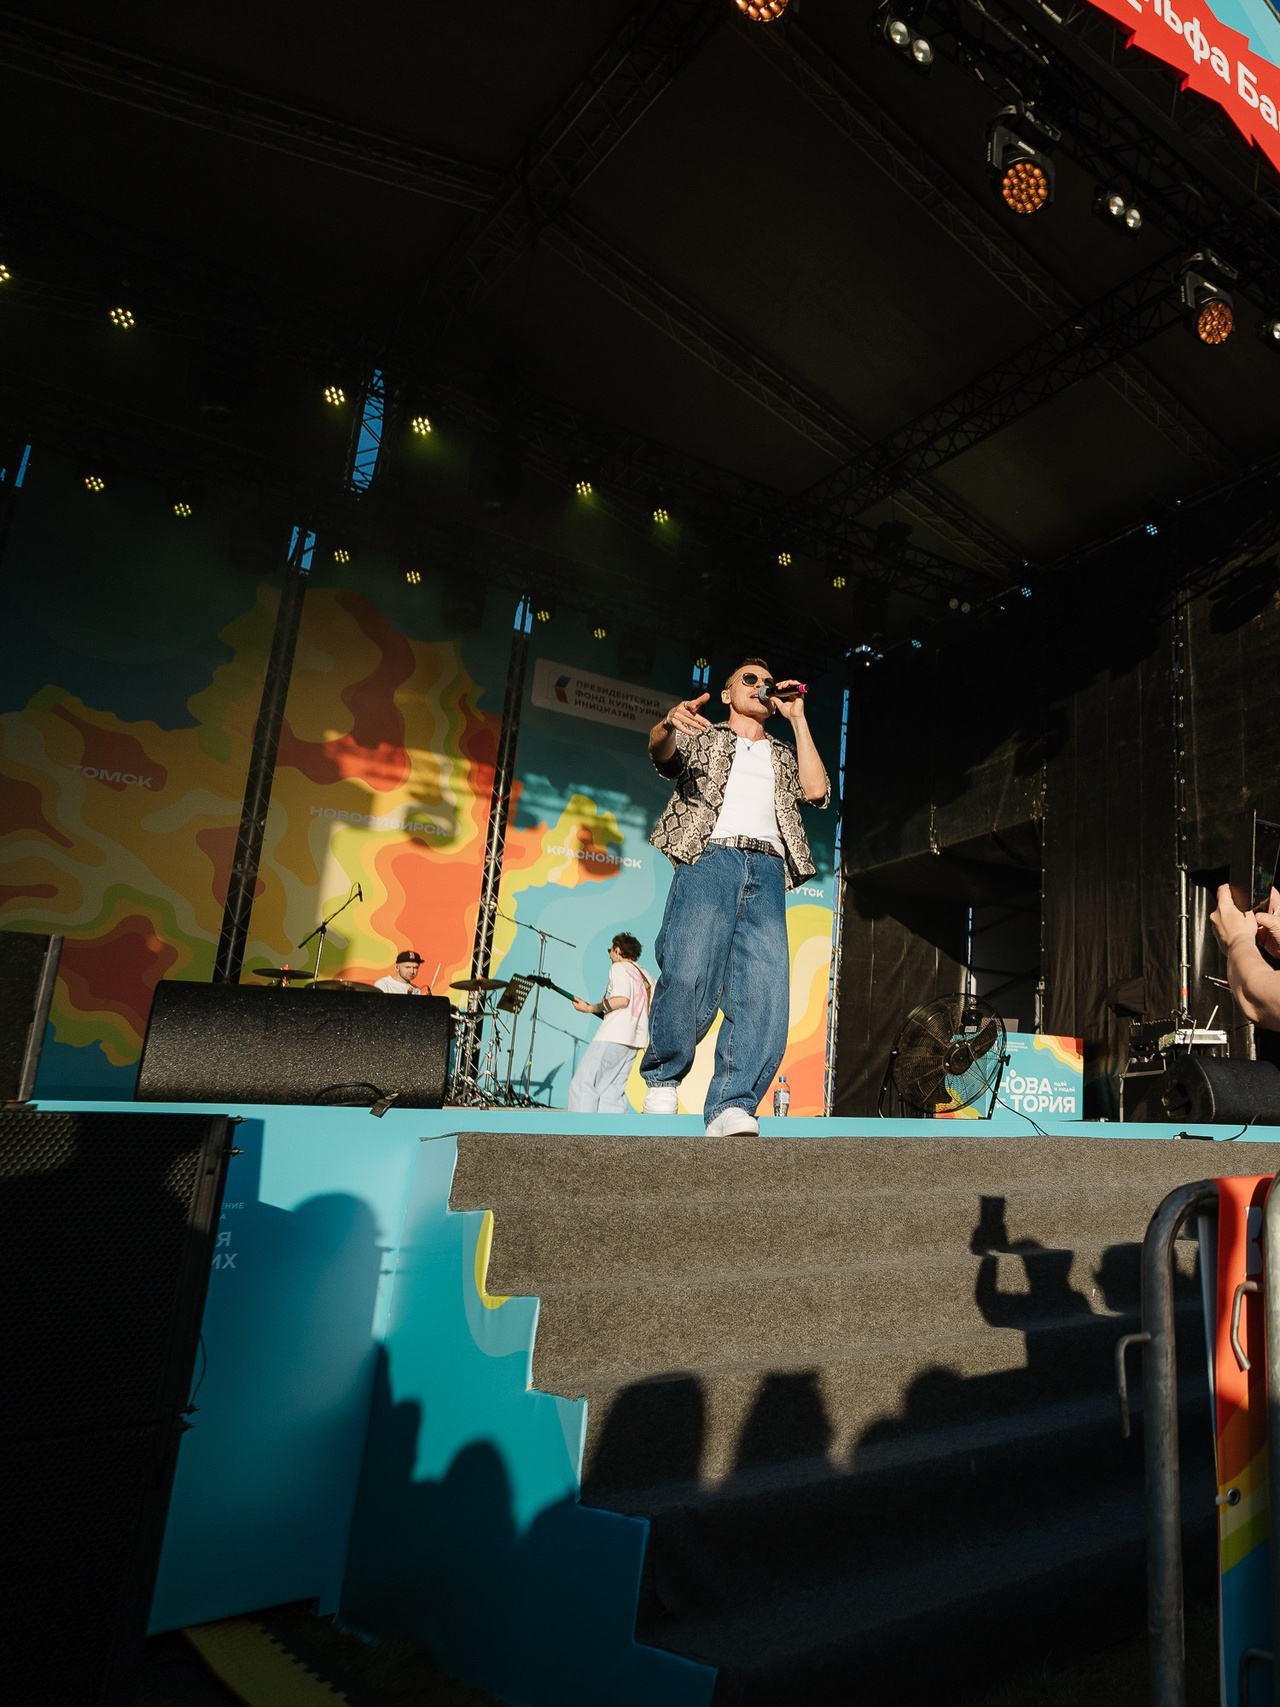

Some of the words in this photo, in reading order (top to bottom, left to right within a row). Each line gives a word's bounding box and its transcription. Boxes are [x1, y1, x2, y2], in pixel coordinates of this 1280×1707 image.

[575, 689, 606, 704] ФОНД
[609, 698, 667, 719] КУЛЬТУРНЫ
[576, 680, 660, 709] ПРЕЗИДЕНТСКИЙ
[574, 699, 636, 721] ИНИЦИАТИВ
[69, 764, 153, 789] ТОМСК
[309, 805, 449, 837] НОВОСИБИРСК
[547, 844, 642, 869] КРАСНОЯРСК
[998, 1074, 1053, 1095] НОВА
[1010, 1094, 1076, 1114] ТОРИЯ
